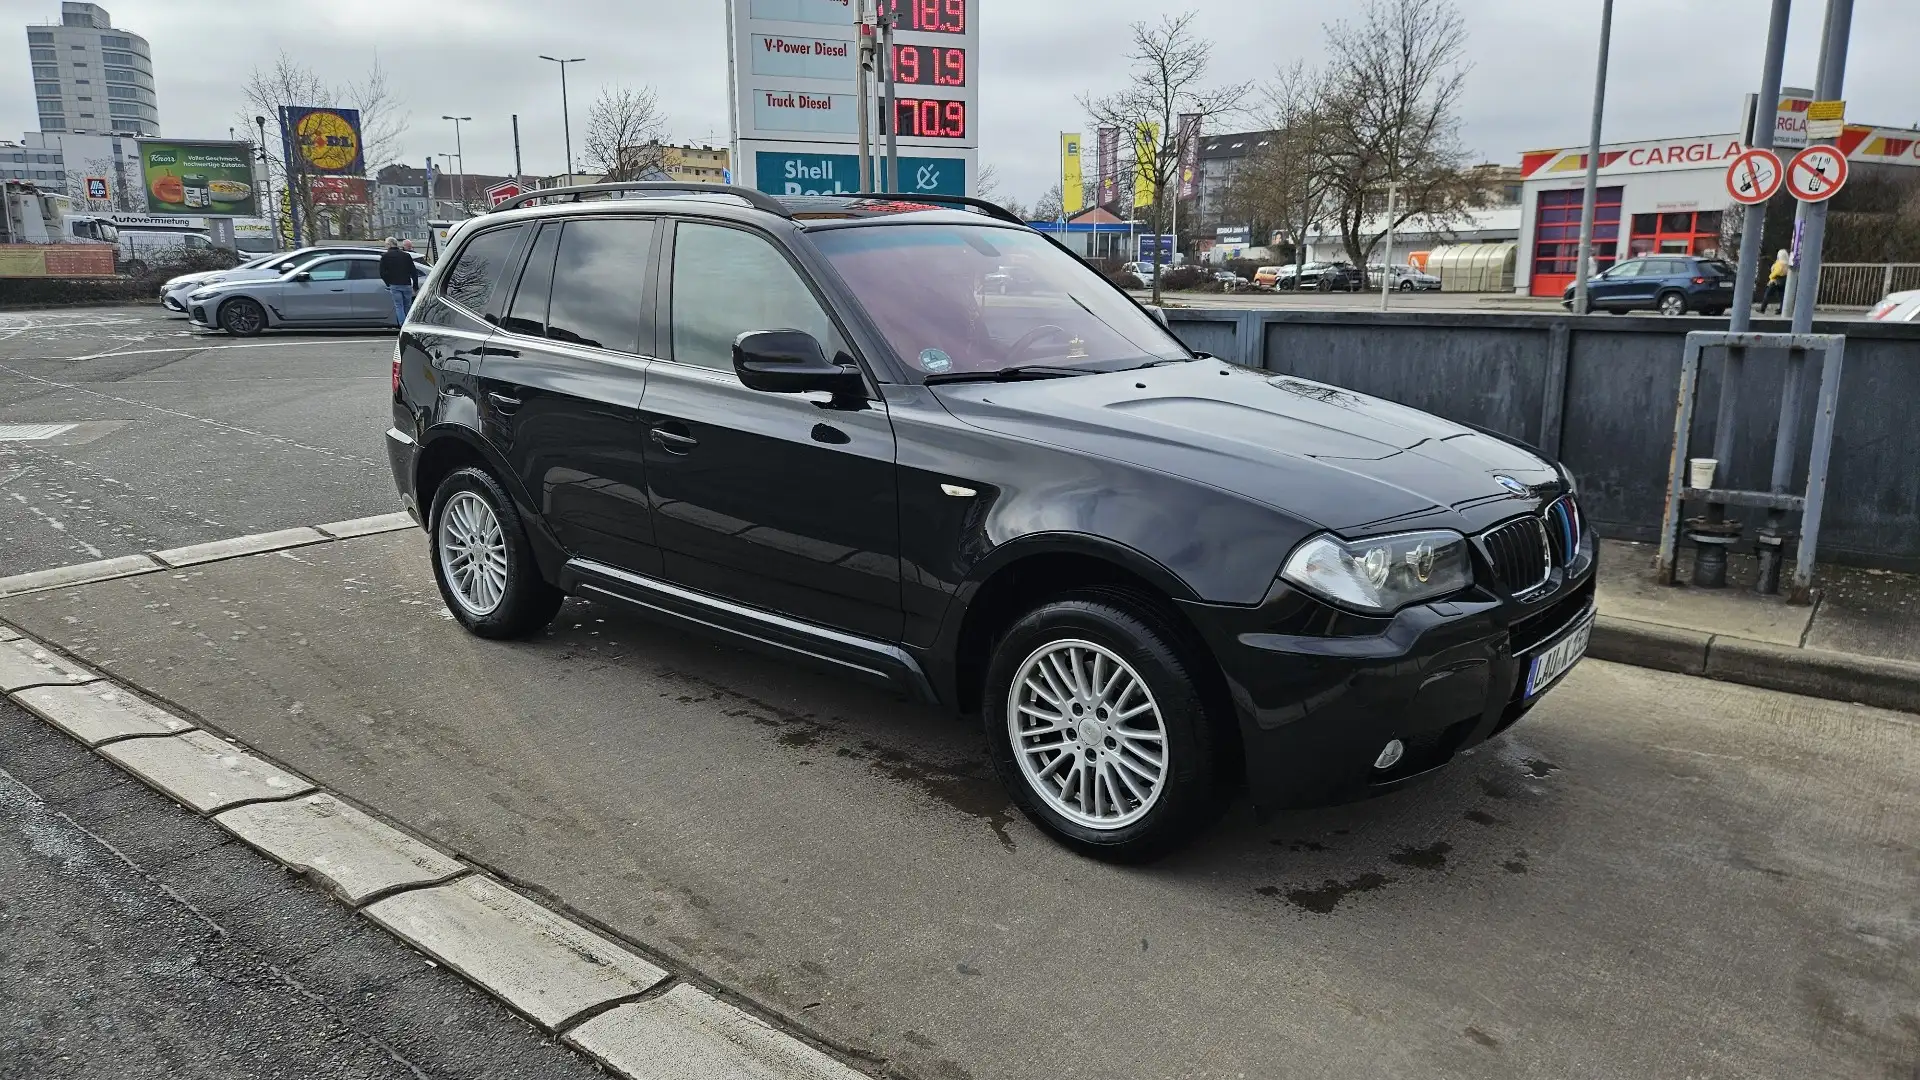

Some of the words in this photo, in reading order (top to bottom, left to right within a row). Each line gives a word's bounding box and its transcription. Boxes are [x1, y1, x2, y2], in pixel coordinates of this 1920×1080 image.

[764, 38, 810, 55] V-Power
[815, 41, 848, 57] Diesel
[766, 93, 795, 108] Truck
[799, 95, 831, 110] Diesel
[150, 154, 176, 163] Knorr
[1628, 141, 1742, 166] CARGLA
[183, 161, 220, 169] hochwertige
[784, 159, 833, 180] Shell
[111, 215, 190, 227] Autovermietung
